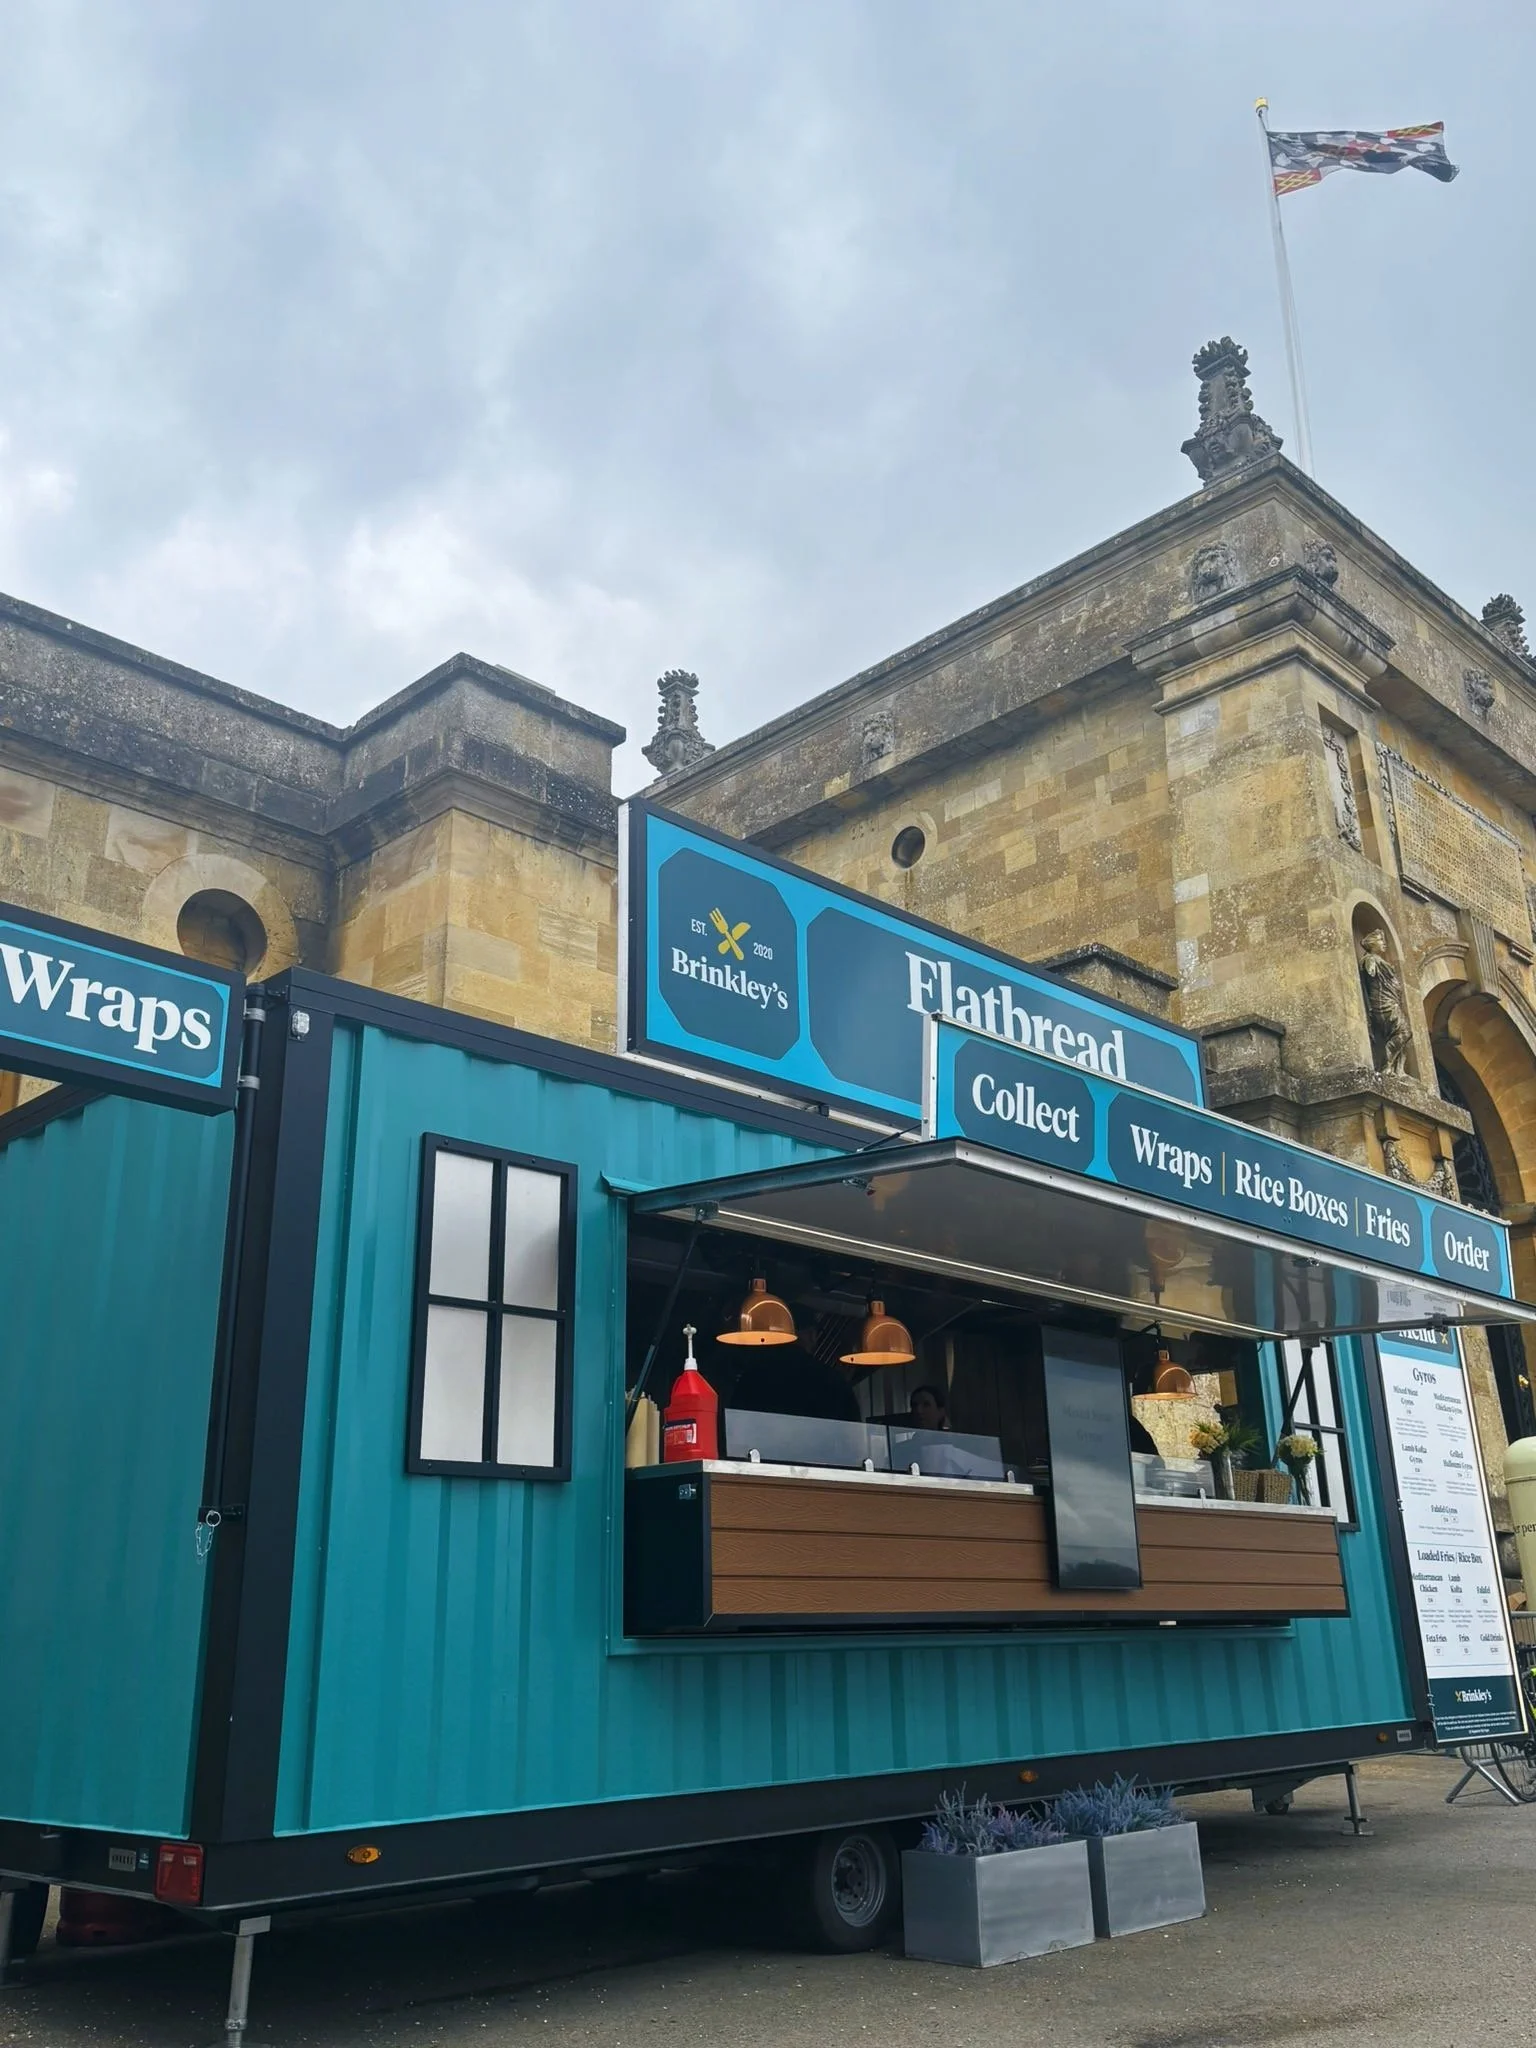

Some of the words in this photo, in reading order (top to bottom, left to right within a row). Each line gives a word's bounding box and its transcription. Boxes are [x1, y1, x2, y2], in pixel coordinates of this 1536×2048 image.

[691, 918, 708, 936] EST.
[753, 942, 773, 960] 2020
[0, 943, 212, 1054] Wraps
[671, 946, 789, 1010] Brinkley's
[904, 951, 1127, 1081] Flatbread
[971, 1073, 1081, 1142] Collect
[1130, 1123, 1213, 1189] Wraps
[1235, 1159, 1285, 1207] Rice
[1288, 1177, 1349, 1228] Boxes
[1364, 1203, 1411, 1247] Fries
[1443, 1230, 1490, 1272] Order
[1412, 1367, 1437, 1385] Gyros
[1417, 1549, 1440, 1562] Loaded
[1440, 1550, 1455, 1563] Fries
[1458, 1551, 1471, 1563] Rice
[1462, 1688, 1492, 1704] Brinkley's
